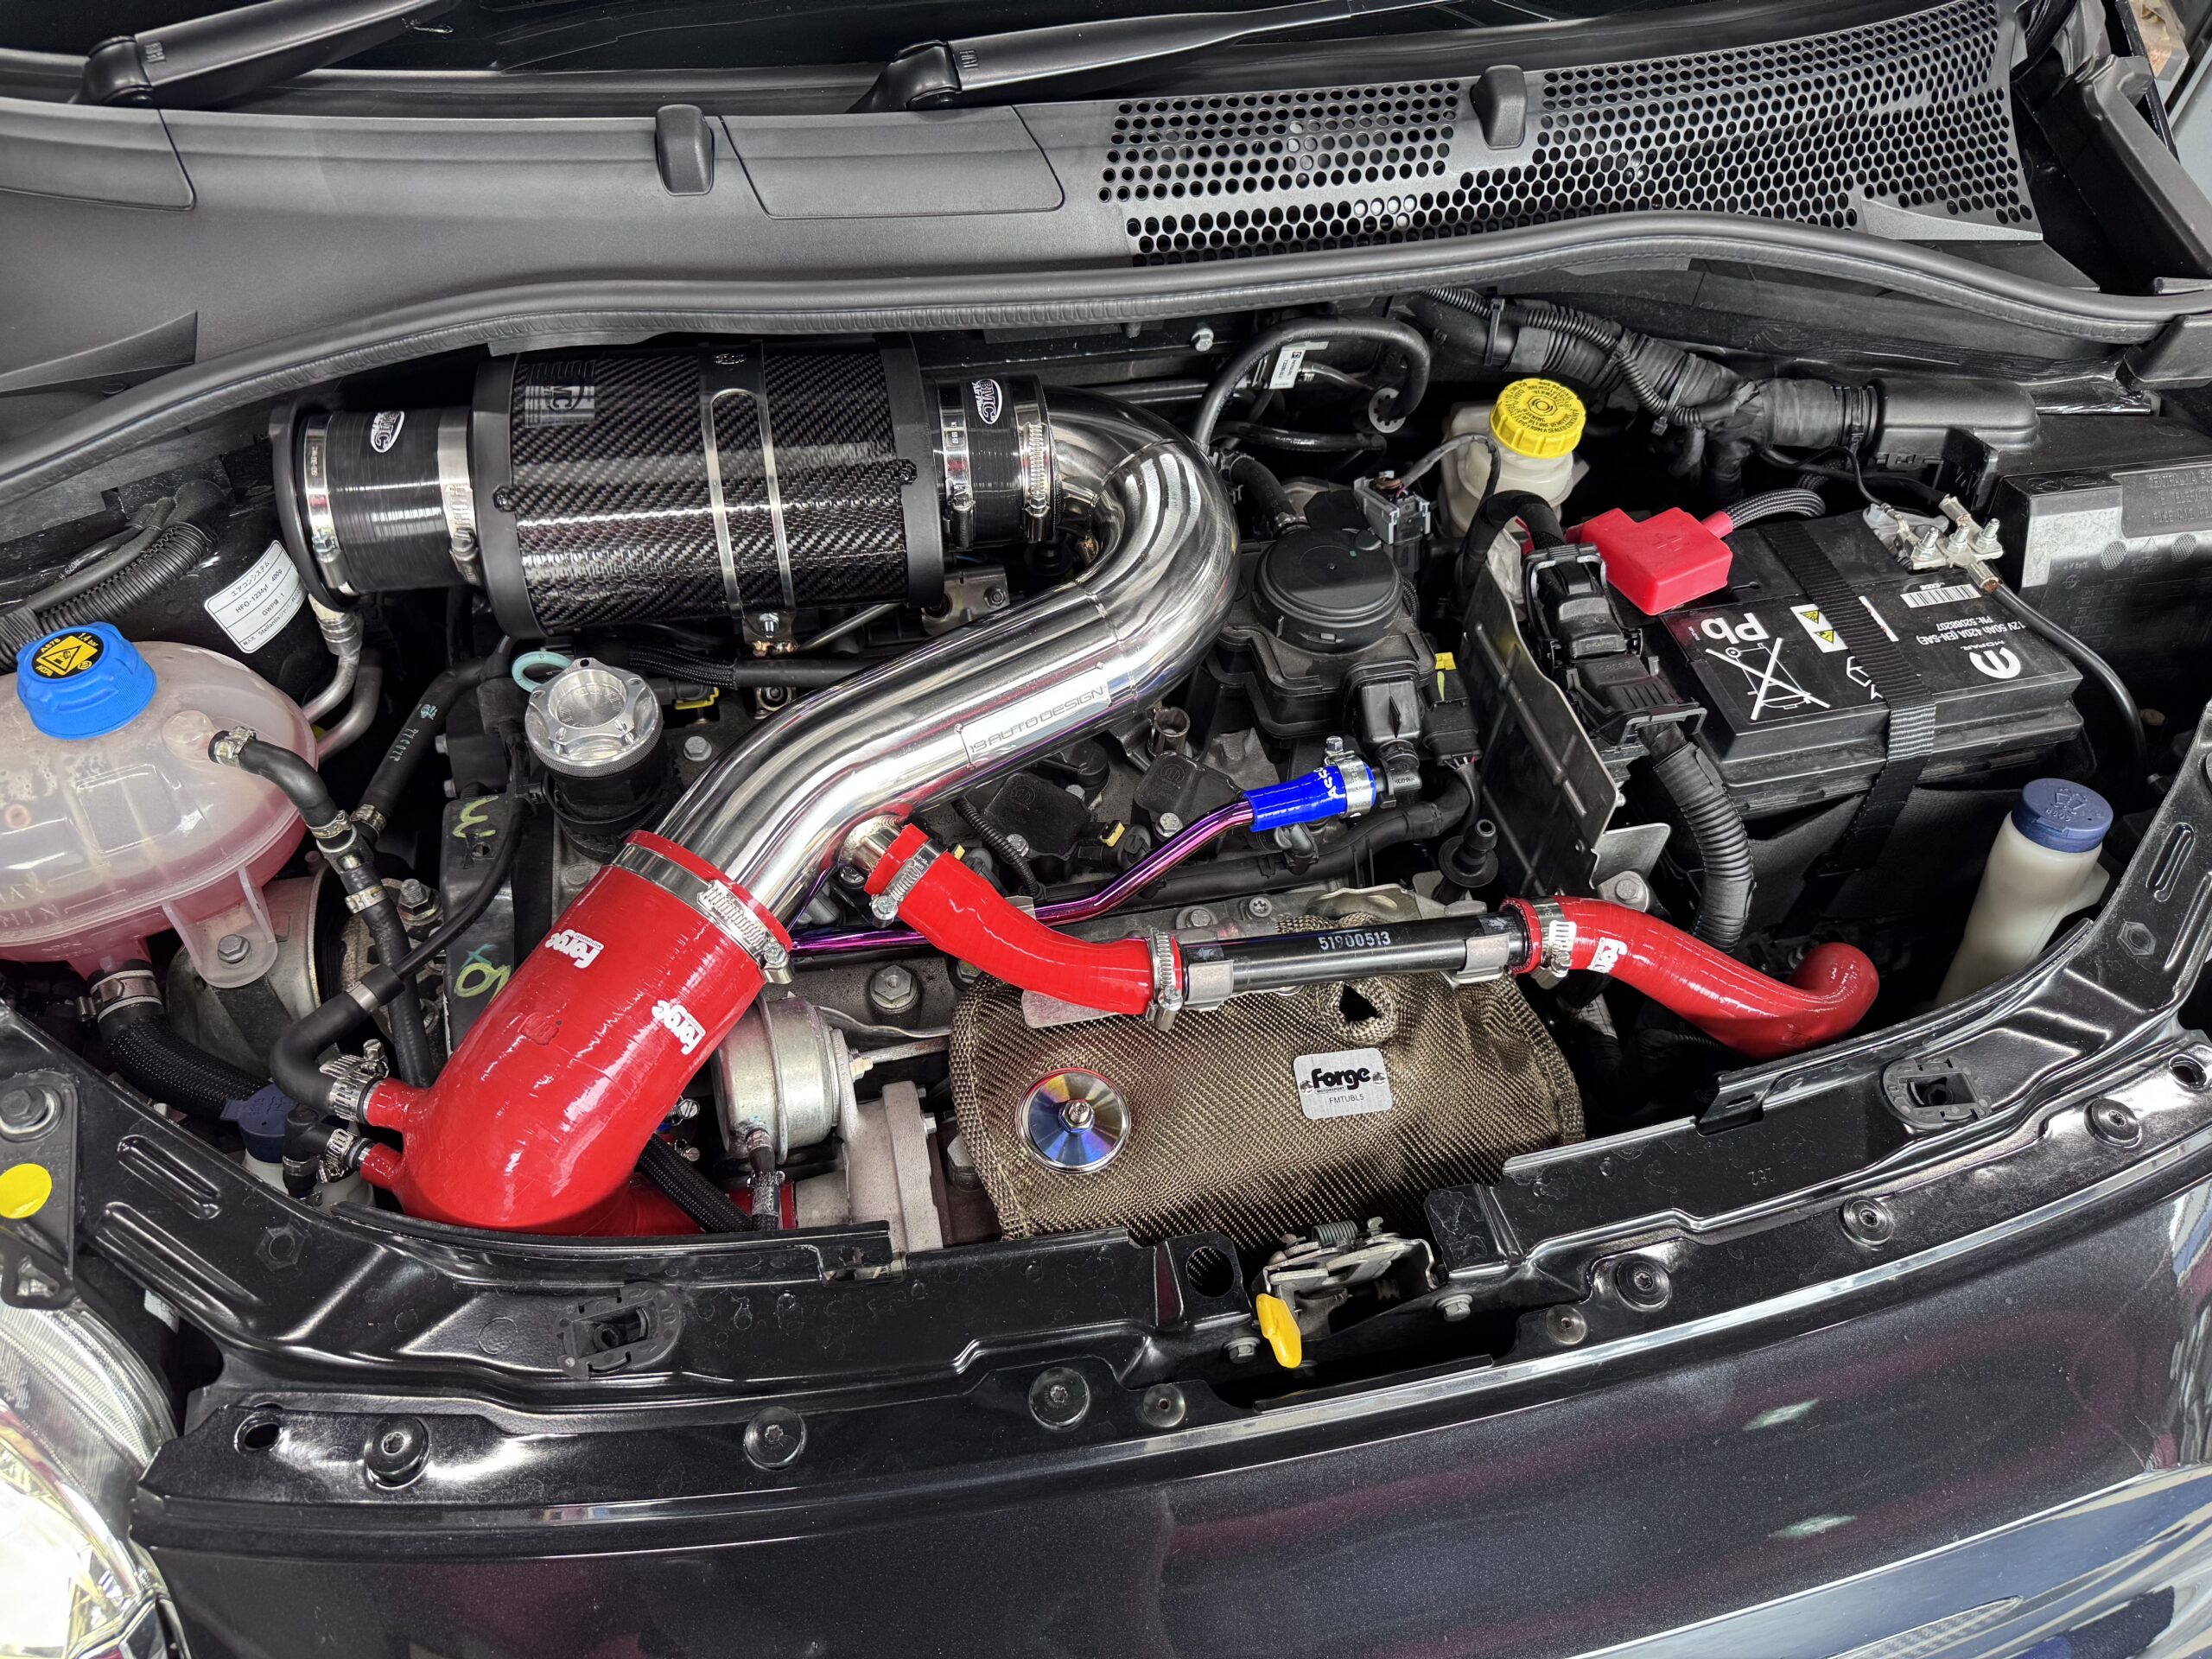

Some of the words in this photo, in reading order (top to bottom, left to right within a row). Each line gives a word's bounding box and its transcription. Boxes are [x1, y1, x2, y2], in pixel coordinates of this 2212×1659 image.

[981, 380, 997, 419] BMC
[1700, 612, 1770, 645] Pb
[1936, 617, 1976, 632] 52088207
[1982, 624, 2008, 636] 50Ah
[2008, 620, 2026, 632] 12V
[1318, 931, 1391, 951] 51900513
[1329, 1093, 1364, 1104] FMTUBL5
